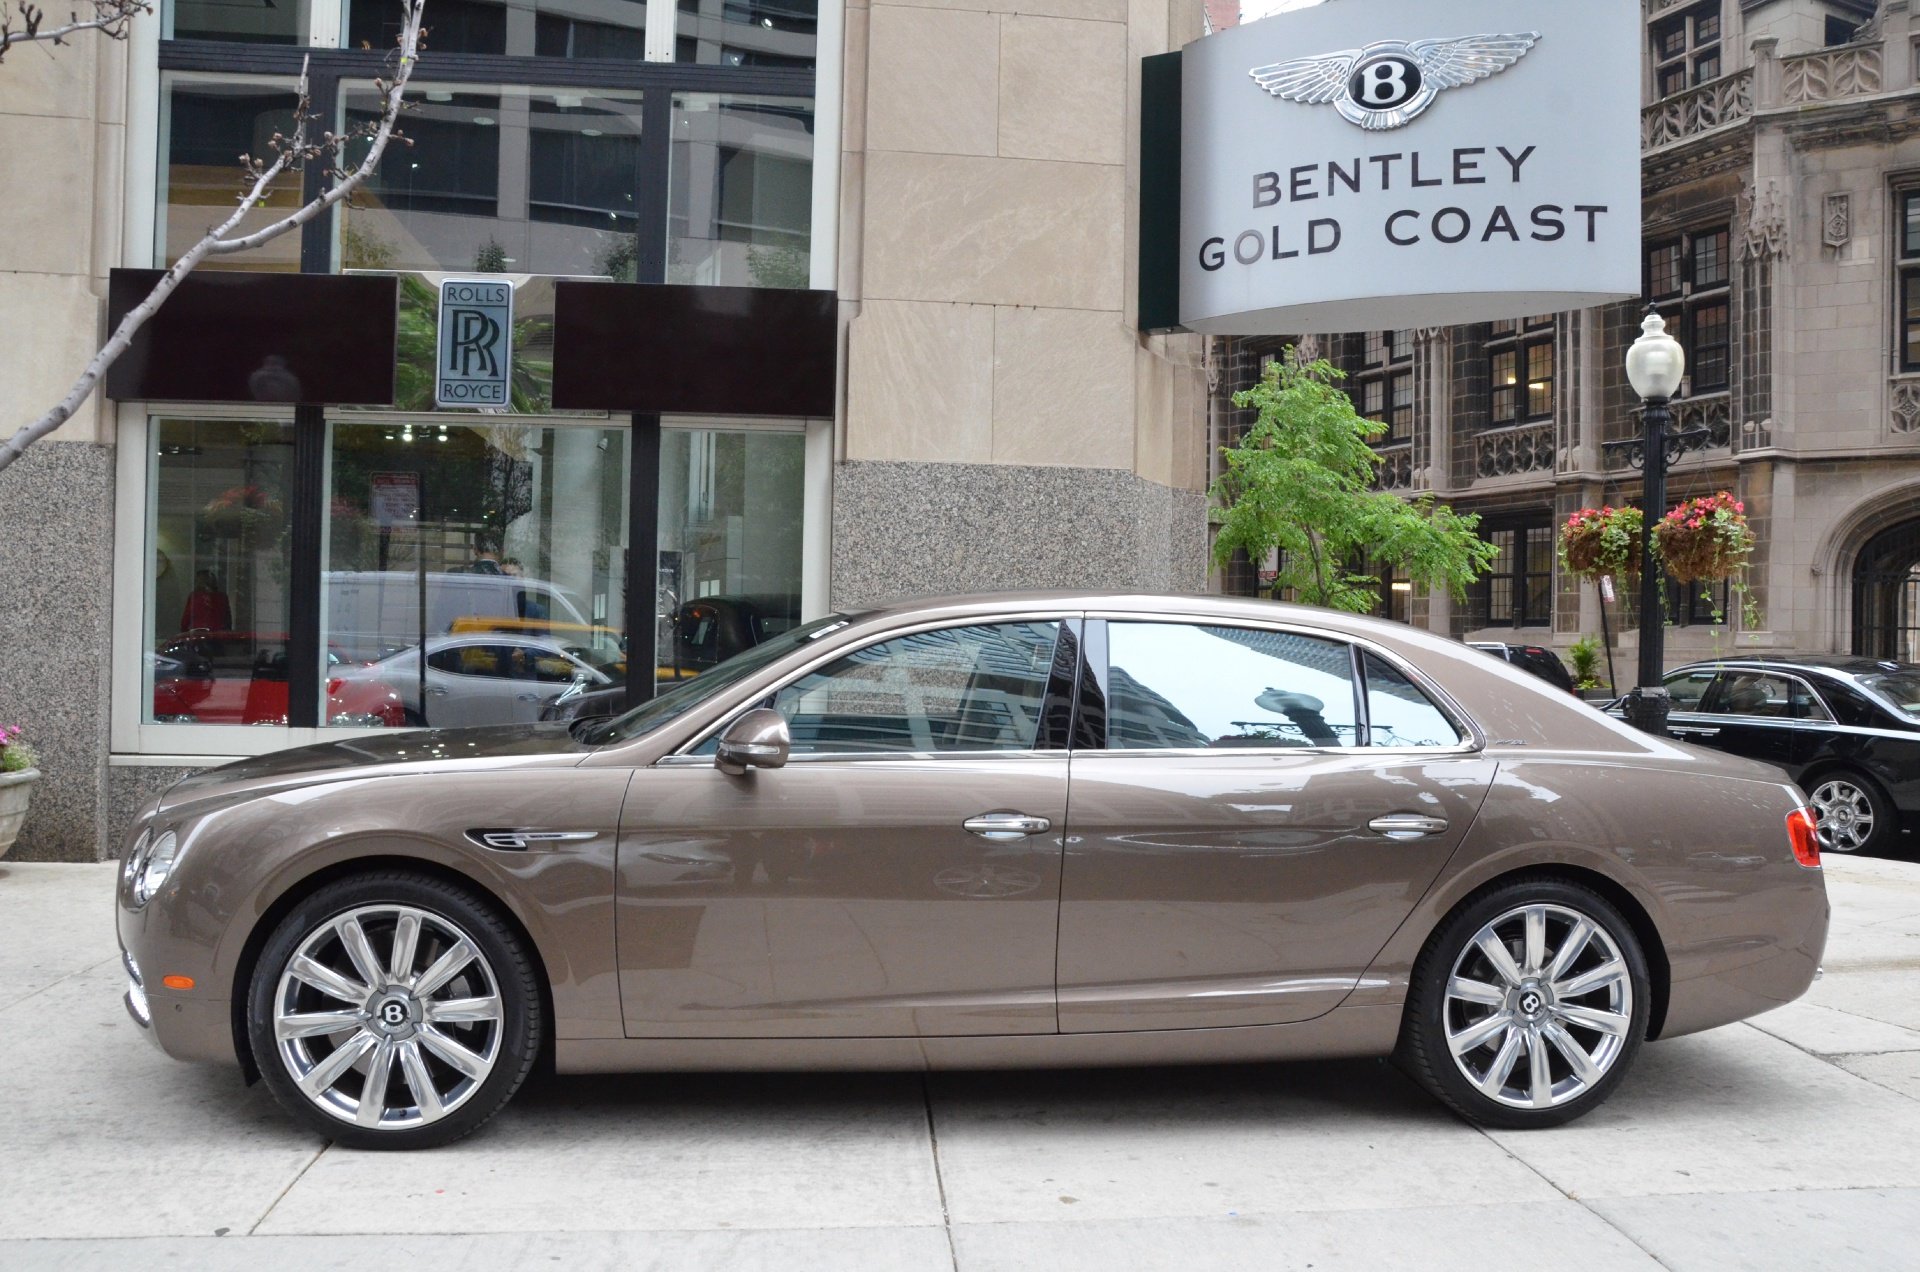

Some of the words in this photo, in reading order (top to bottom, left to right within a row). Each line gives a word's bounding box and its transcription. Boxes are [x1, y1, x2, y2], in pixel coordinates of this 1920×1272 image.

[1253, 145, 1537, 209] BENTLEY
[1199, 217, 1342, 272] GOLD
[1384, 204, 1609, 247] COAST
[447, 287, 505, 302] ROLLS
[443, 383, 501, 399] ROYCE
